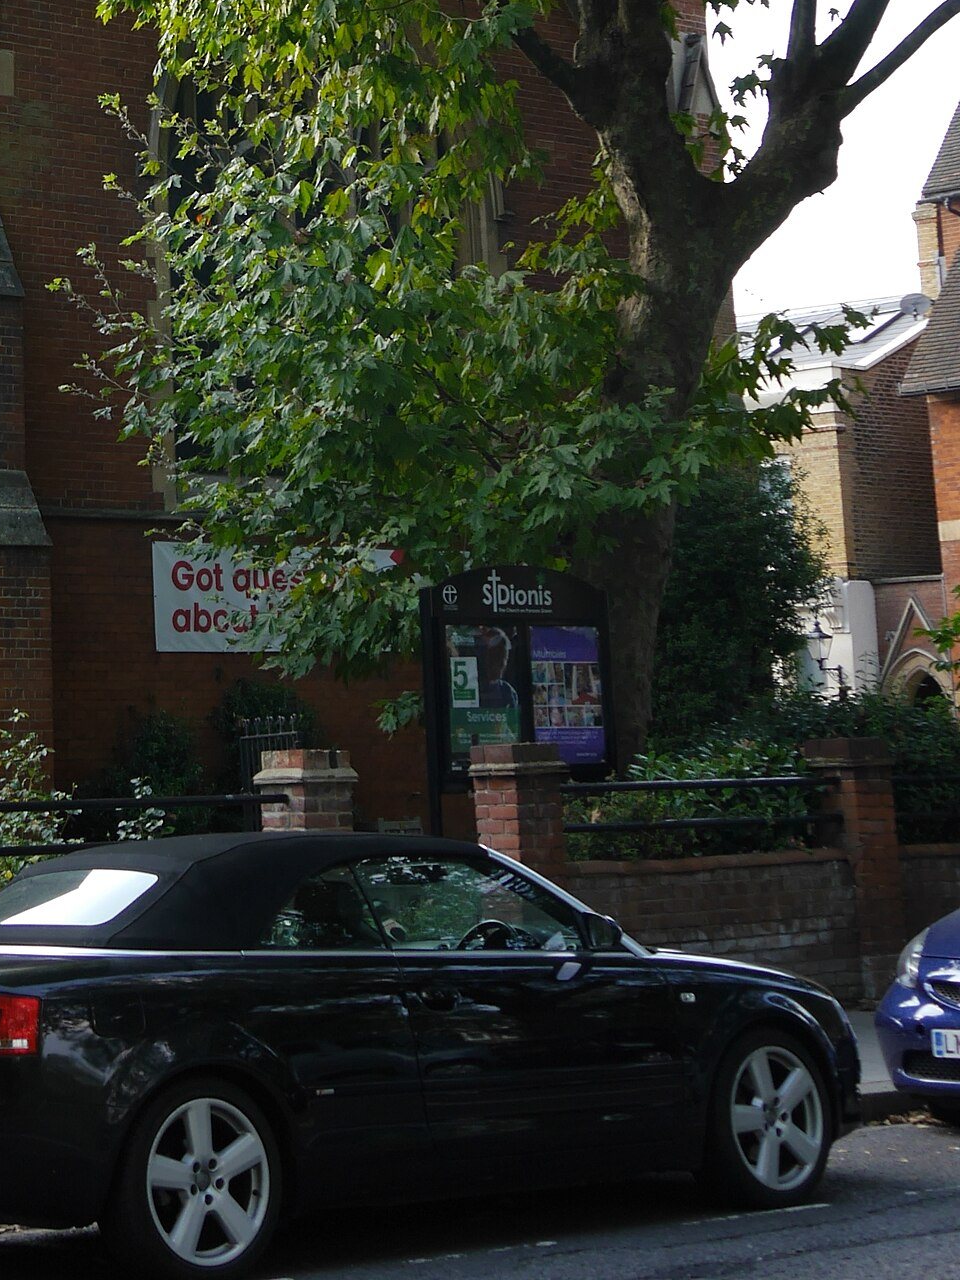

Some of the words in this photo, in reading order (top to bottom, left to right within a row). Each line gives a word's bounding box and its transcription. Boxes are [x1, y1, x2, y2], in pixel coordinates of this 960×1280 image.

[171, 560, 224, 592] Got
[453, 661, 468, 689] 5
[466, 711, 507, 722] Services
